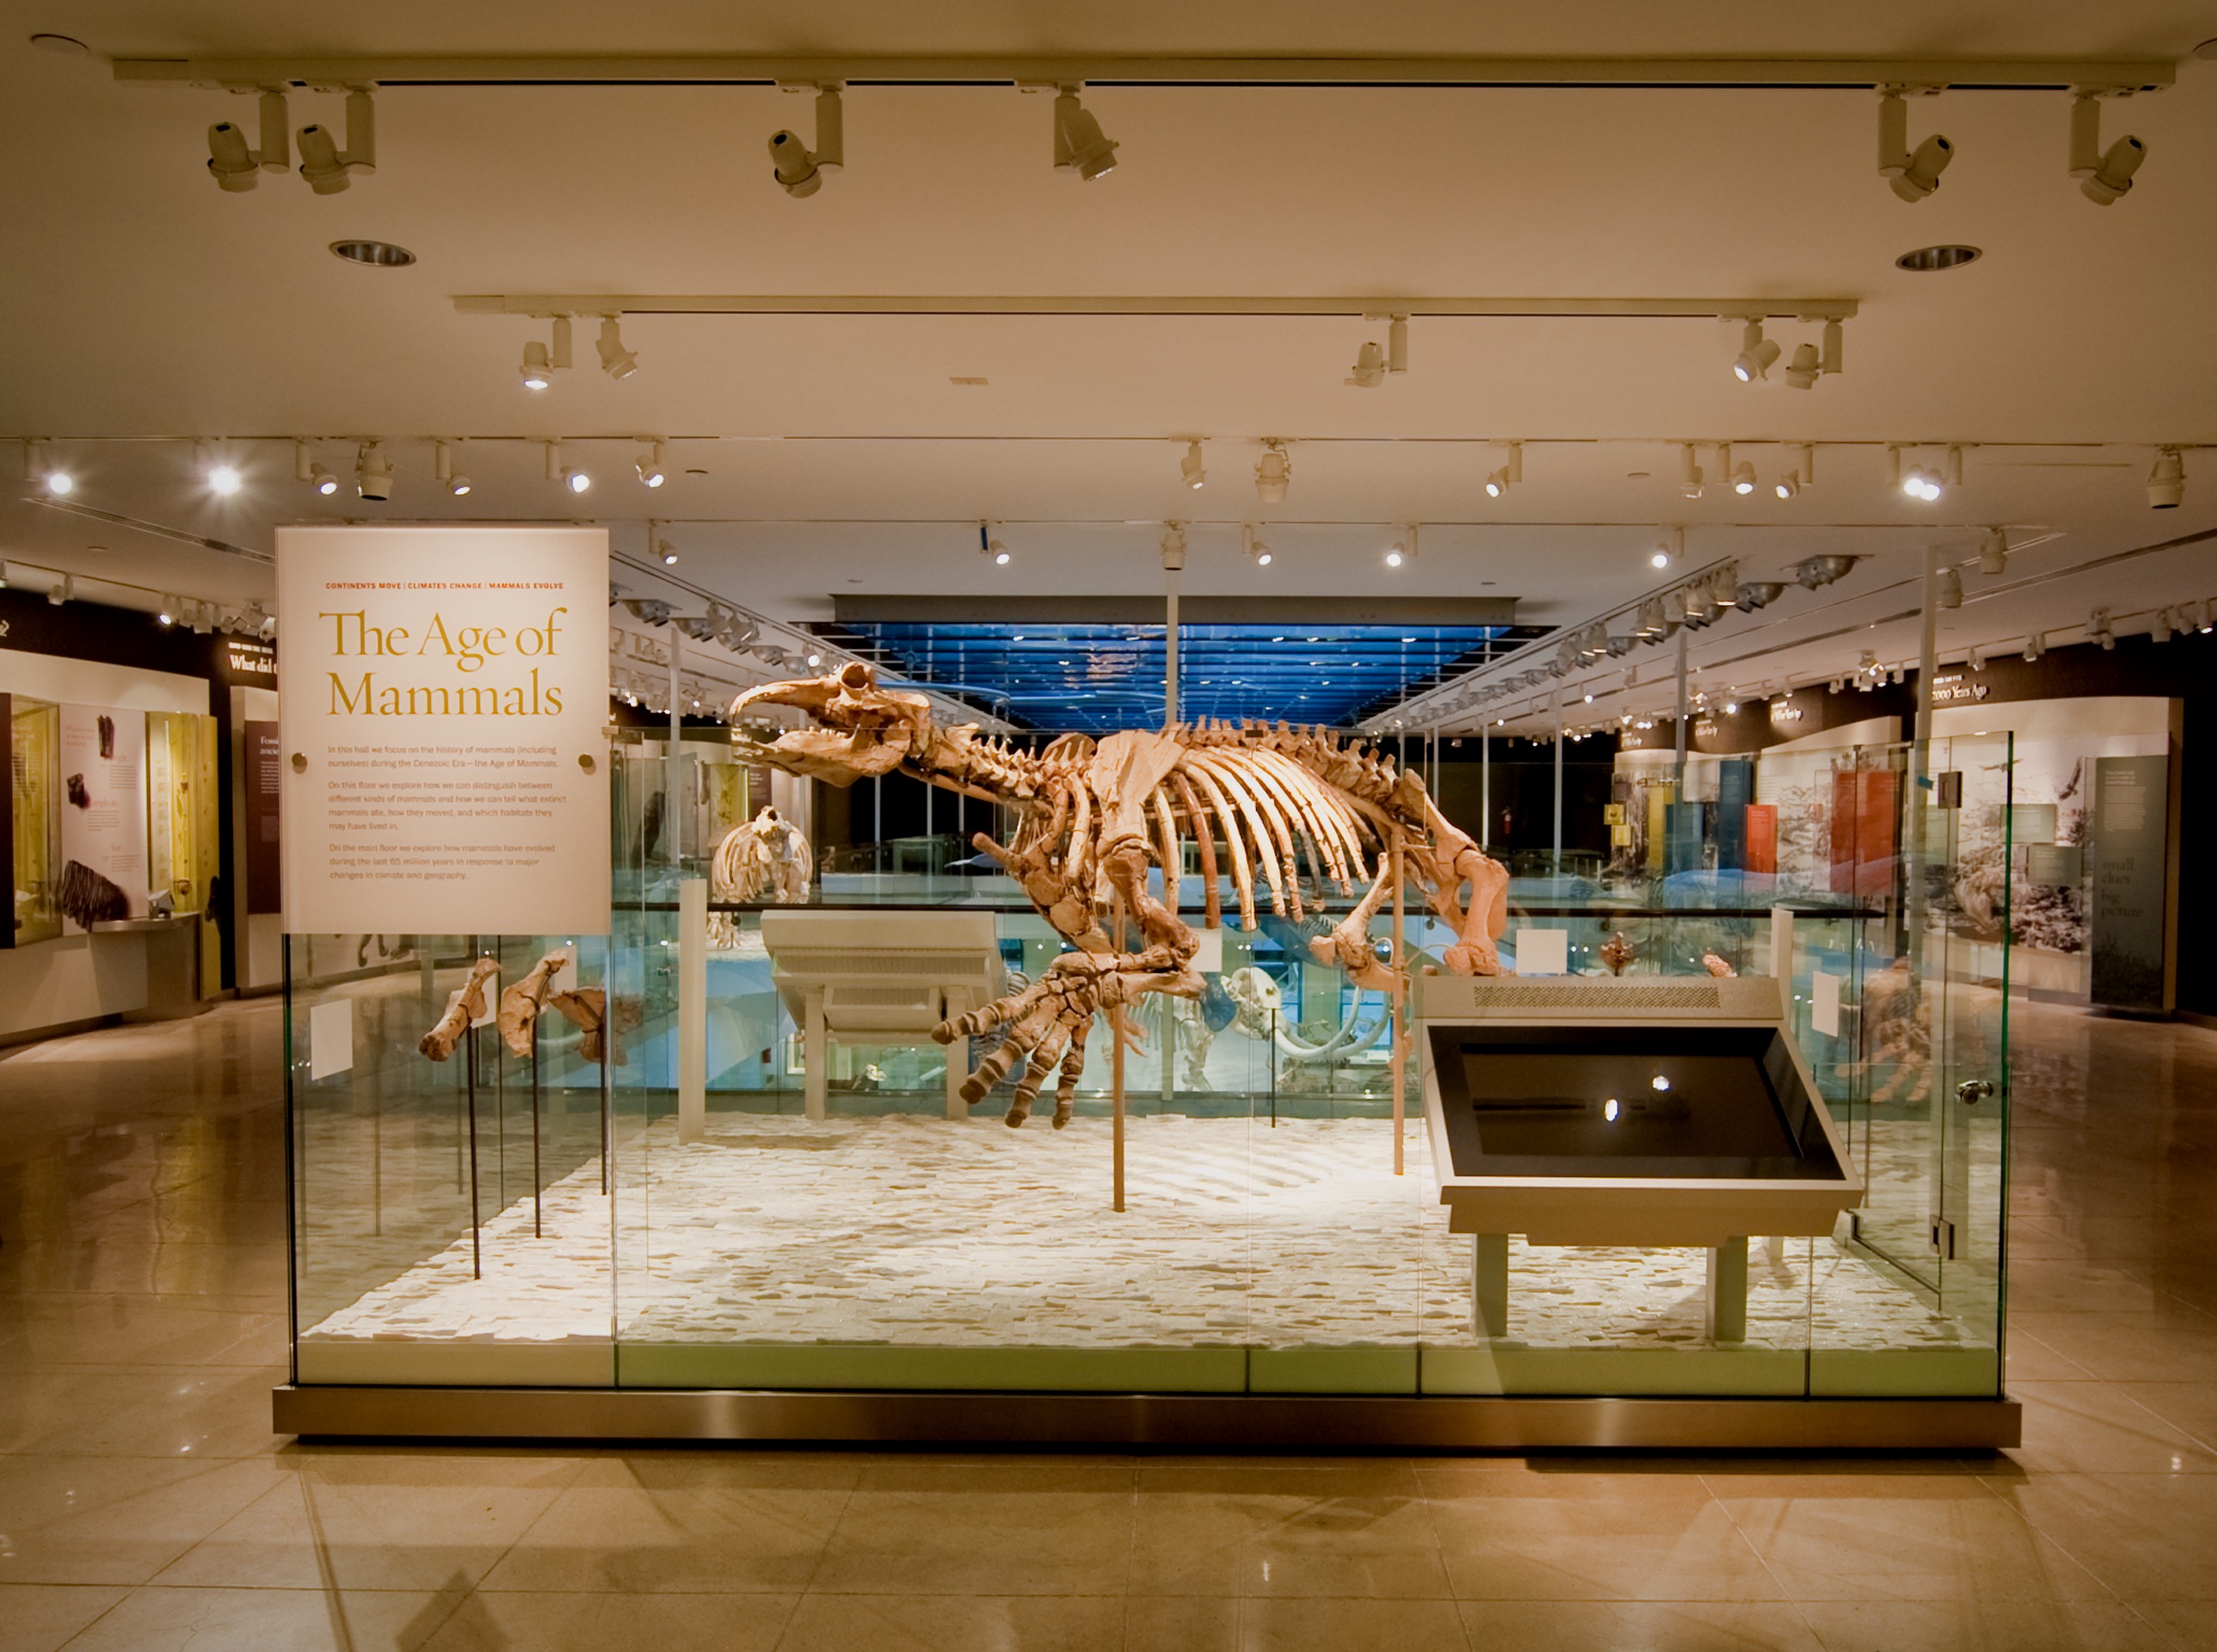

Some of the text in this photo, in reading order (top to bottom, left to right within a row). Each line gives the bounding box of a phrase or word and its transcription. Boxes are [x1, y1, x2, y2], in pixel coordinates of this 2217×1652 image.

[324, 582, 377, 590] CONTINENTS
[378, 582, 402, 590] MOVE
[407, 582, 447, 590] CLIMATES
[449, 582, 483, 590] CHANGE
[488, 582, 531, 590] MAMMALS
[533, 582, 564, 590] EVOLVE
[318, 607, 568, 673] The Age of
[229, 654, 256, 672] What
[256, 656, 273, 674] did
[324, 667, 563, 717] Mammals
[1951, 685, 1971, 699] Years
[1971, 683, 1987, 700] Ago
[327, 745, 336, 754] In
[336, 745, 354, 755] this
[354, 745, 370, 754] hall
[384, 745, 407, 755] focus
[420, 745, 434, 755] the
[435, 746, 465, 755] history
[465, 745, 474, 754] of
[474, 745, 516, 755] mammals
[516, 745, 557, 756] (including
[370, 759, 397, 769] during
[397, 759, 412, 768] the
[413, 759, 451, 768] Cenozoic
[474, 759, 489, 768] the
[489, 759, 505, 769] Age
[506, 759, 515, 767] of
[516, 759, 560, 767] Mammals.
[328, 780, 341, 790] On
[341, 781, 357, 790] this
[358, 780, 377, 790] floor
[391, 781, 422, 791] explore
[422, 781, 441, 790] how
[471, 781, 517, 792] distinguish
[517, 781, 553, 790] between
[363, 795, 385, 804] kinds
[386, 794, 396, 803] of
[396, 795, 437, 804] mammals
[437, 794, 454, 804] and
[454, 795, 473, 804] how
[503, 794, 517, 804] tell
[517, 795, 539, 804] what
[539, 795, 568, 804] extinct
[328, 808, 370, 817] mammals
[387, 808, 405, 817] how
[405, 809, 425, 818] they
[425, 808, 456, 818] moved,
[457, 808, 473, 817] and
[474, 808, 499, 817] which
[500, 808, 533, 817] habitats
[534, 809, 553, 818] they
[328, 823, 347, 832] may
[347, 822, 367, 830] have
[368, 822, 388, 830] lived
[329, 843, 342, 853] On
[342, 843, 357, 853] the
[379, 843, 397, 853] floor
[411, 844, 443, 854] explore
[443, 843, 461, 853] how
[461, 843, 502, 853] mammals
[503, 844, 524, 853] have
[524, 844, 556, 853] evolved
[329, 857, 356, 867] during
[357, 857, 372, 866] the
[373, 857, 388, 866] last
[389, 857, 402, 866] 65
[403, 857, 431, 866] million
[431, 859, 455, 867] years
[465, 859, 504, 867] response
[504, 858, 514, 866] to
[515, 858, 540, 867] major
[329, 871, 364, 881] changes
[374, 871, 405, 880] climate
[423, 871, 468, 881] geography.
